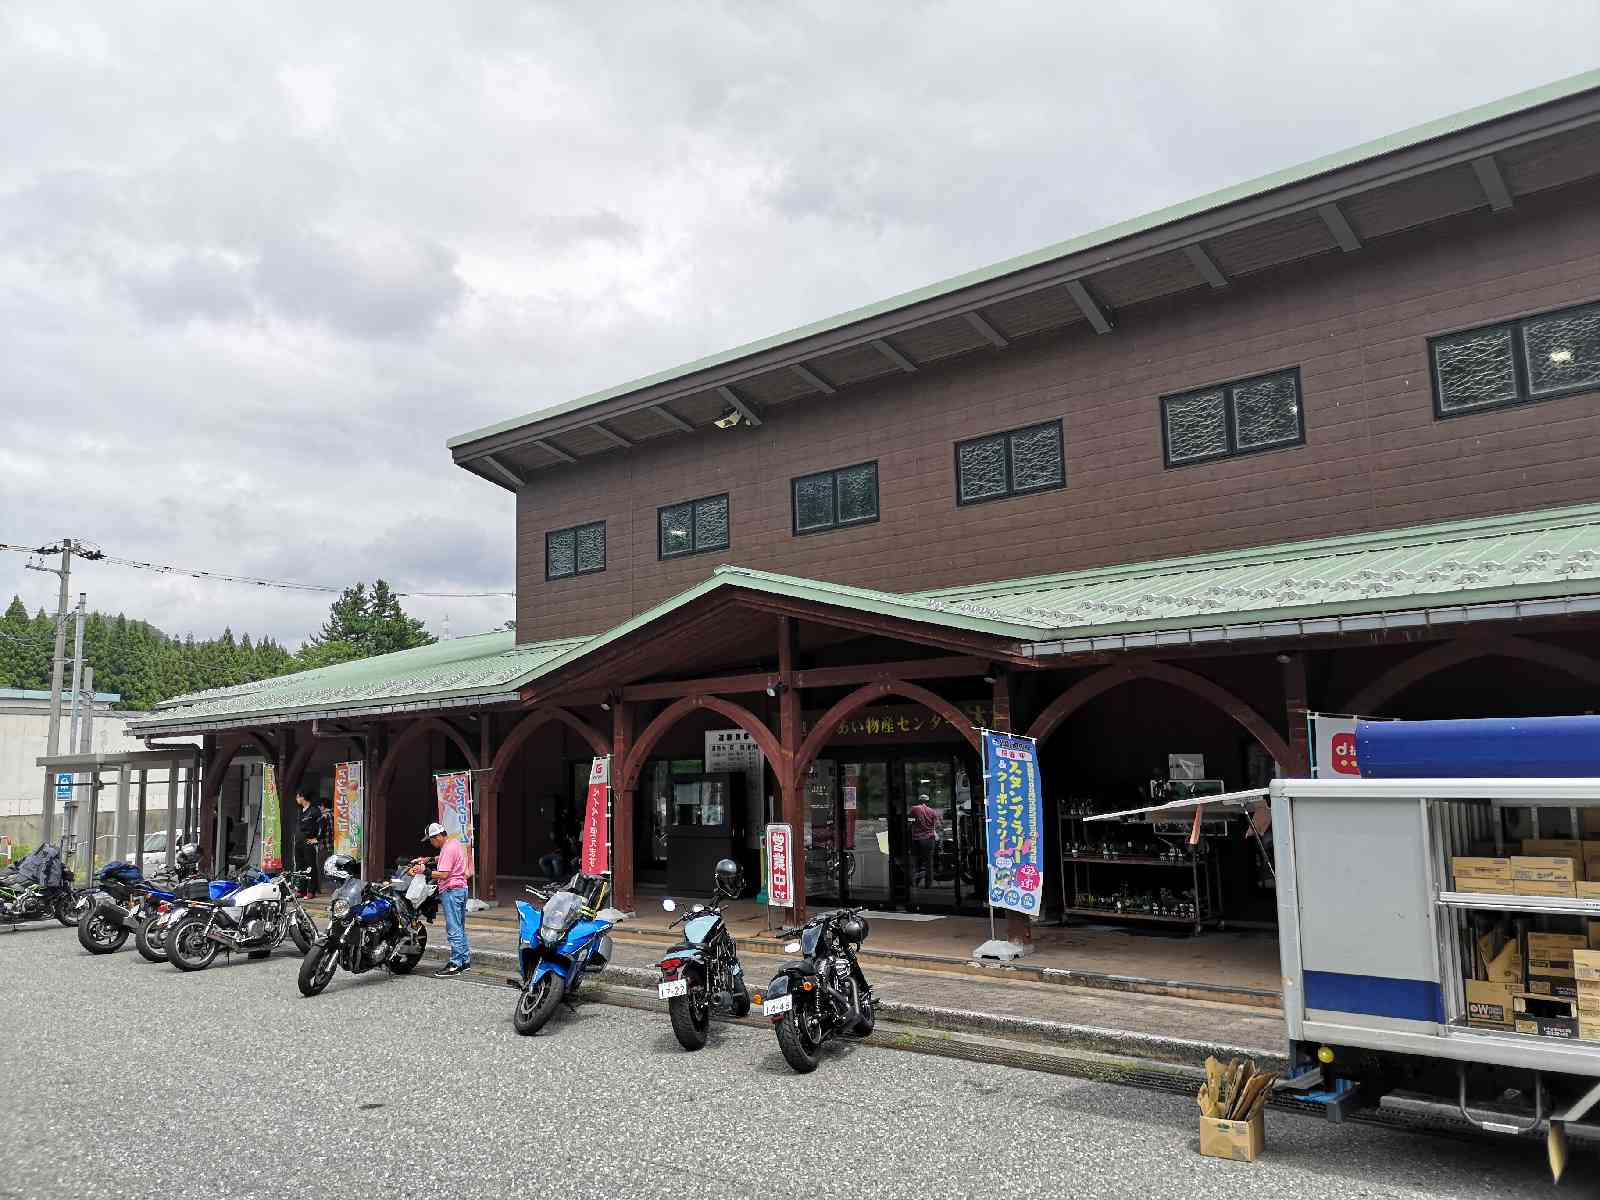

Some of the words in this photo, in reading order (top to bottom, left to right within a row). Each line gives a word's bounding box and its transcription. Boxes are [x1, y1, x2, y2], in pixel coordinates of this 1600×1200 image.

[1008, 761, 1024, 864] スタンプラリー
